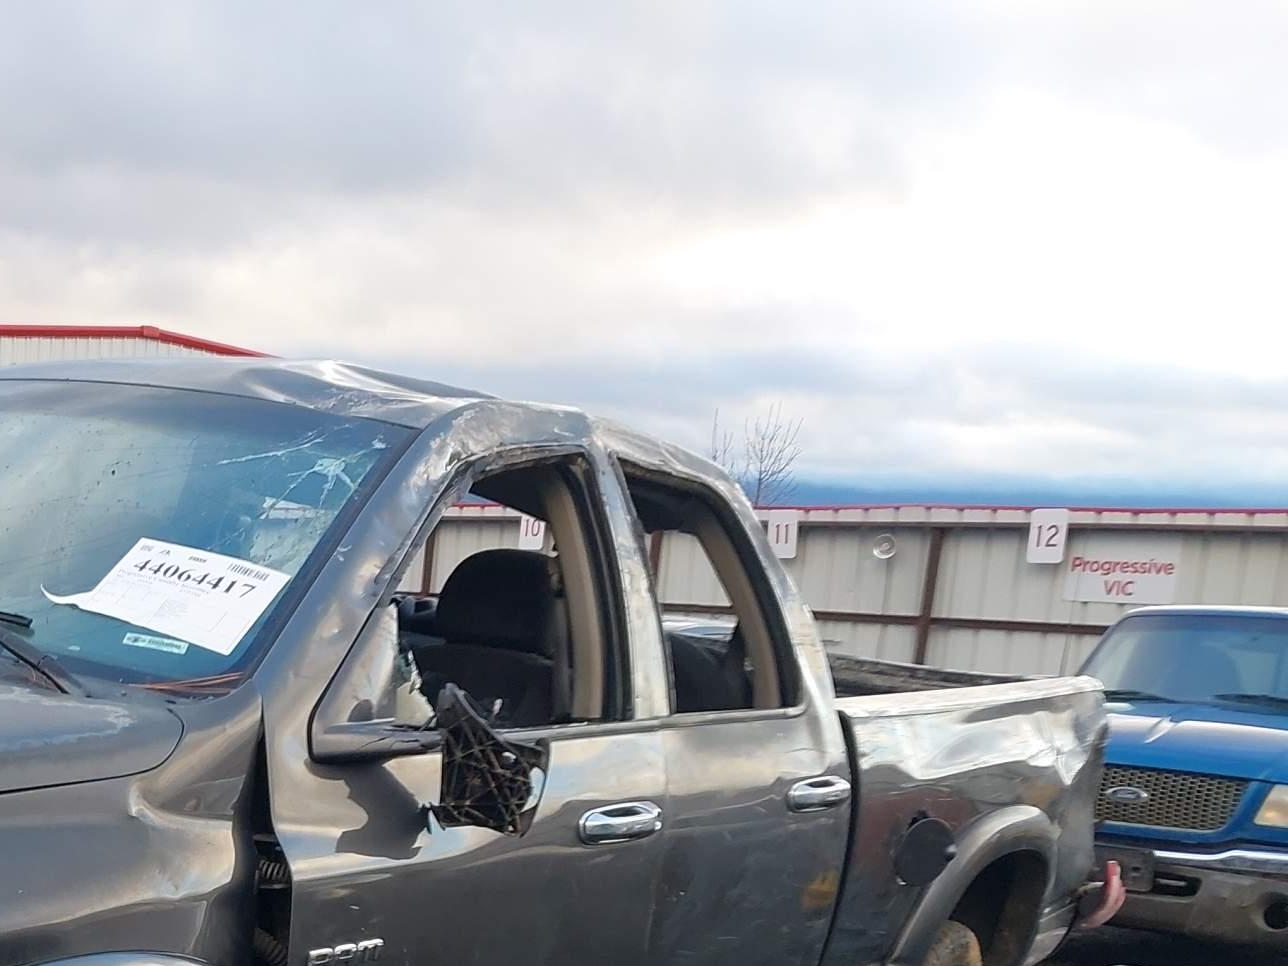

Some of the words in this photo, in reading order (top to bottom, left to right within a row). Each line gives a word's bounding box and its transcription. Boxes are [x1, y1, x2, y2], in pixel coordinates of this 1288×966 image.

[524, 518, 541, 537] 10
[775, 523, 789, 545] 11
[1034, 524, 1060, 548] 12
[1070, 556, 1175, 576] Progressive
[133, 559, 256, 598] 44064417
[1103, 580, 1135, 596] VIC
